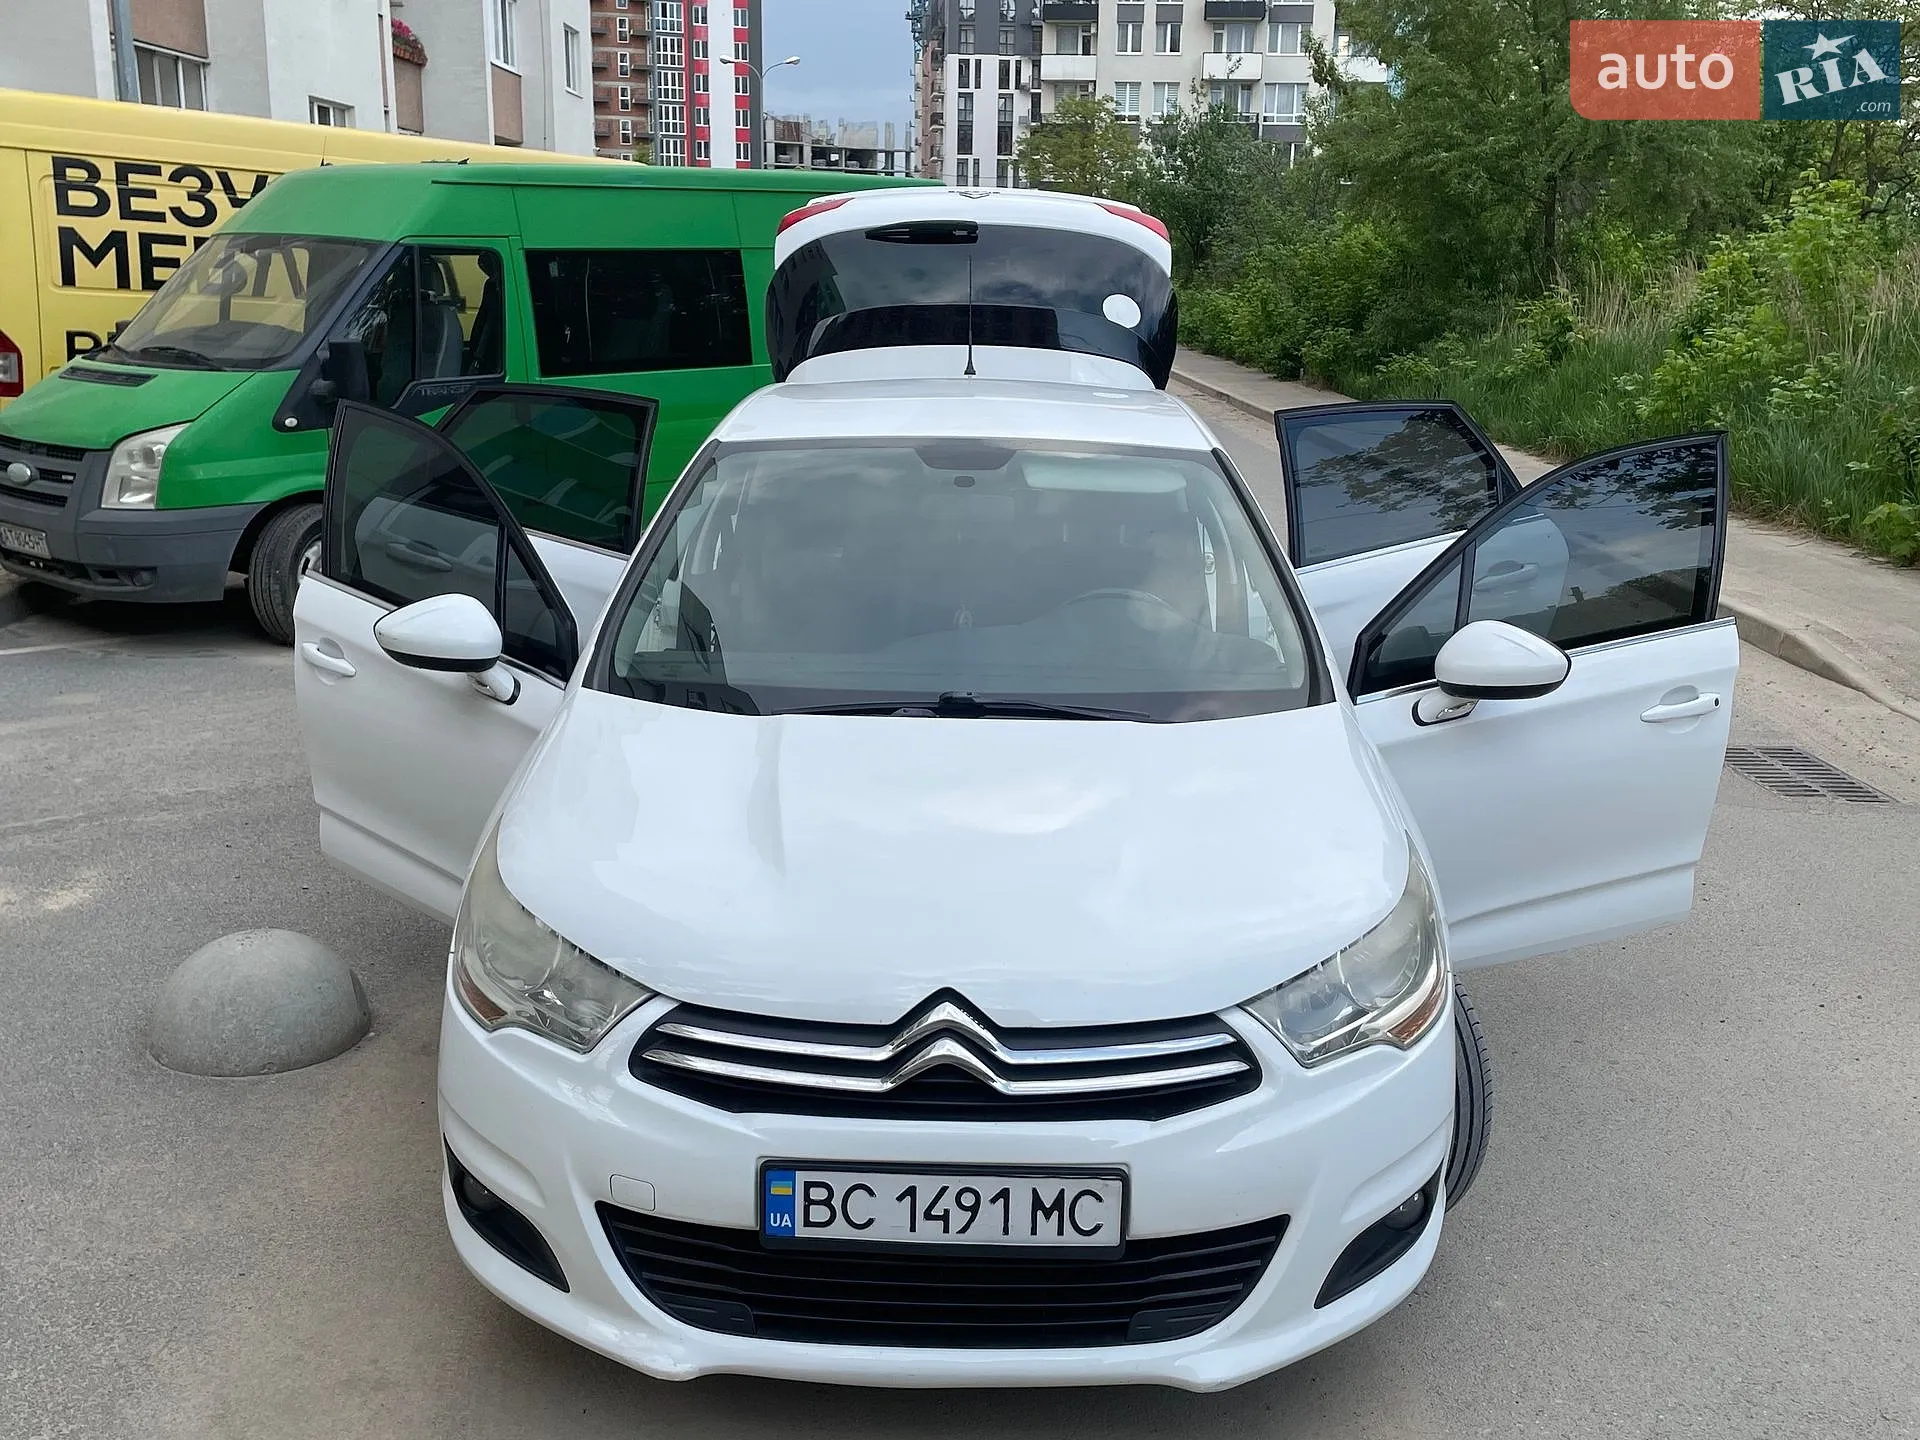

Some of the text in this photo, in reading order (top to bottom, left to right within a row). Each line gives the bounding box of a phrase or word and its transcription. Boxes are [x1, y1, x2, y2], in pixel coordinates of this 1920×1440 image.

[770, 1213, 792, 1228] UA
[802, 1180, 1104, 1237] BC 1491 MC
